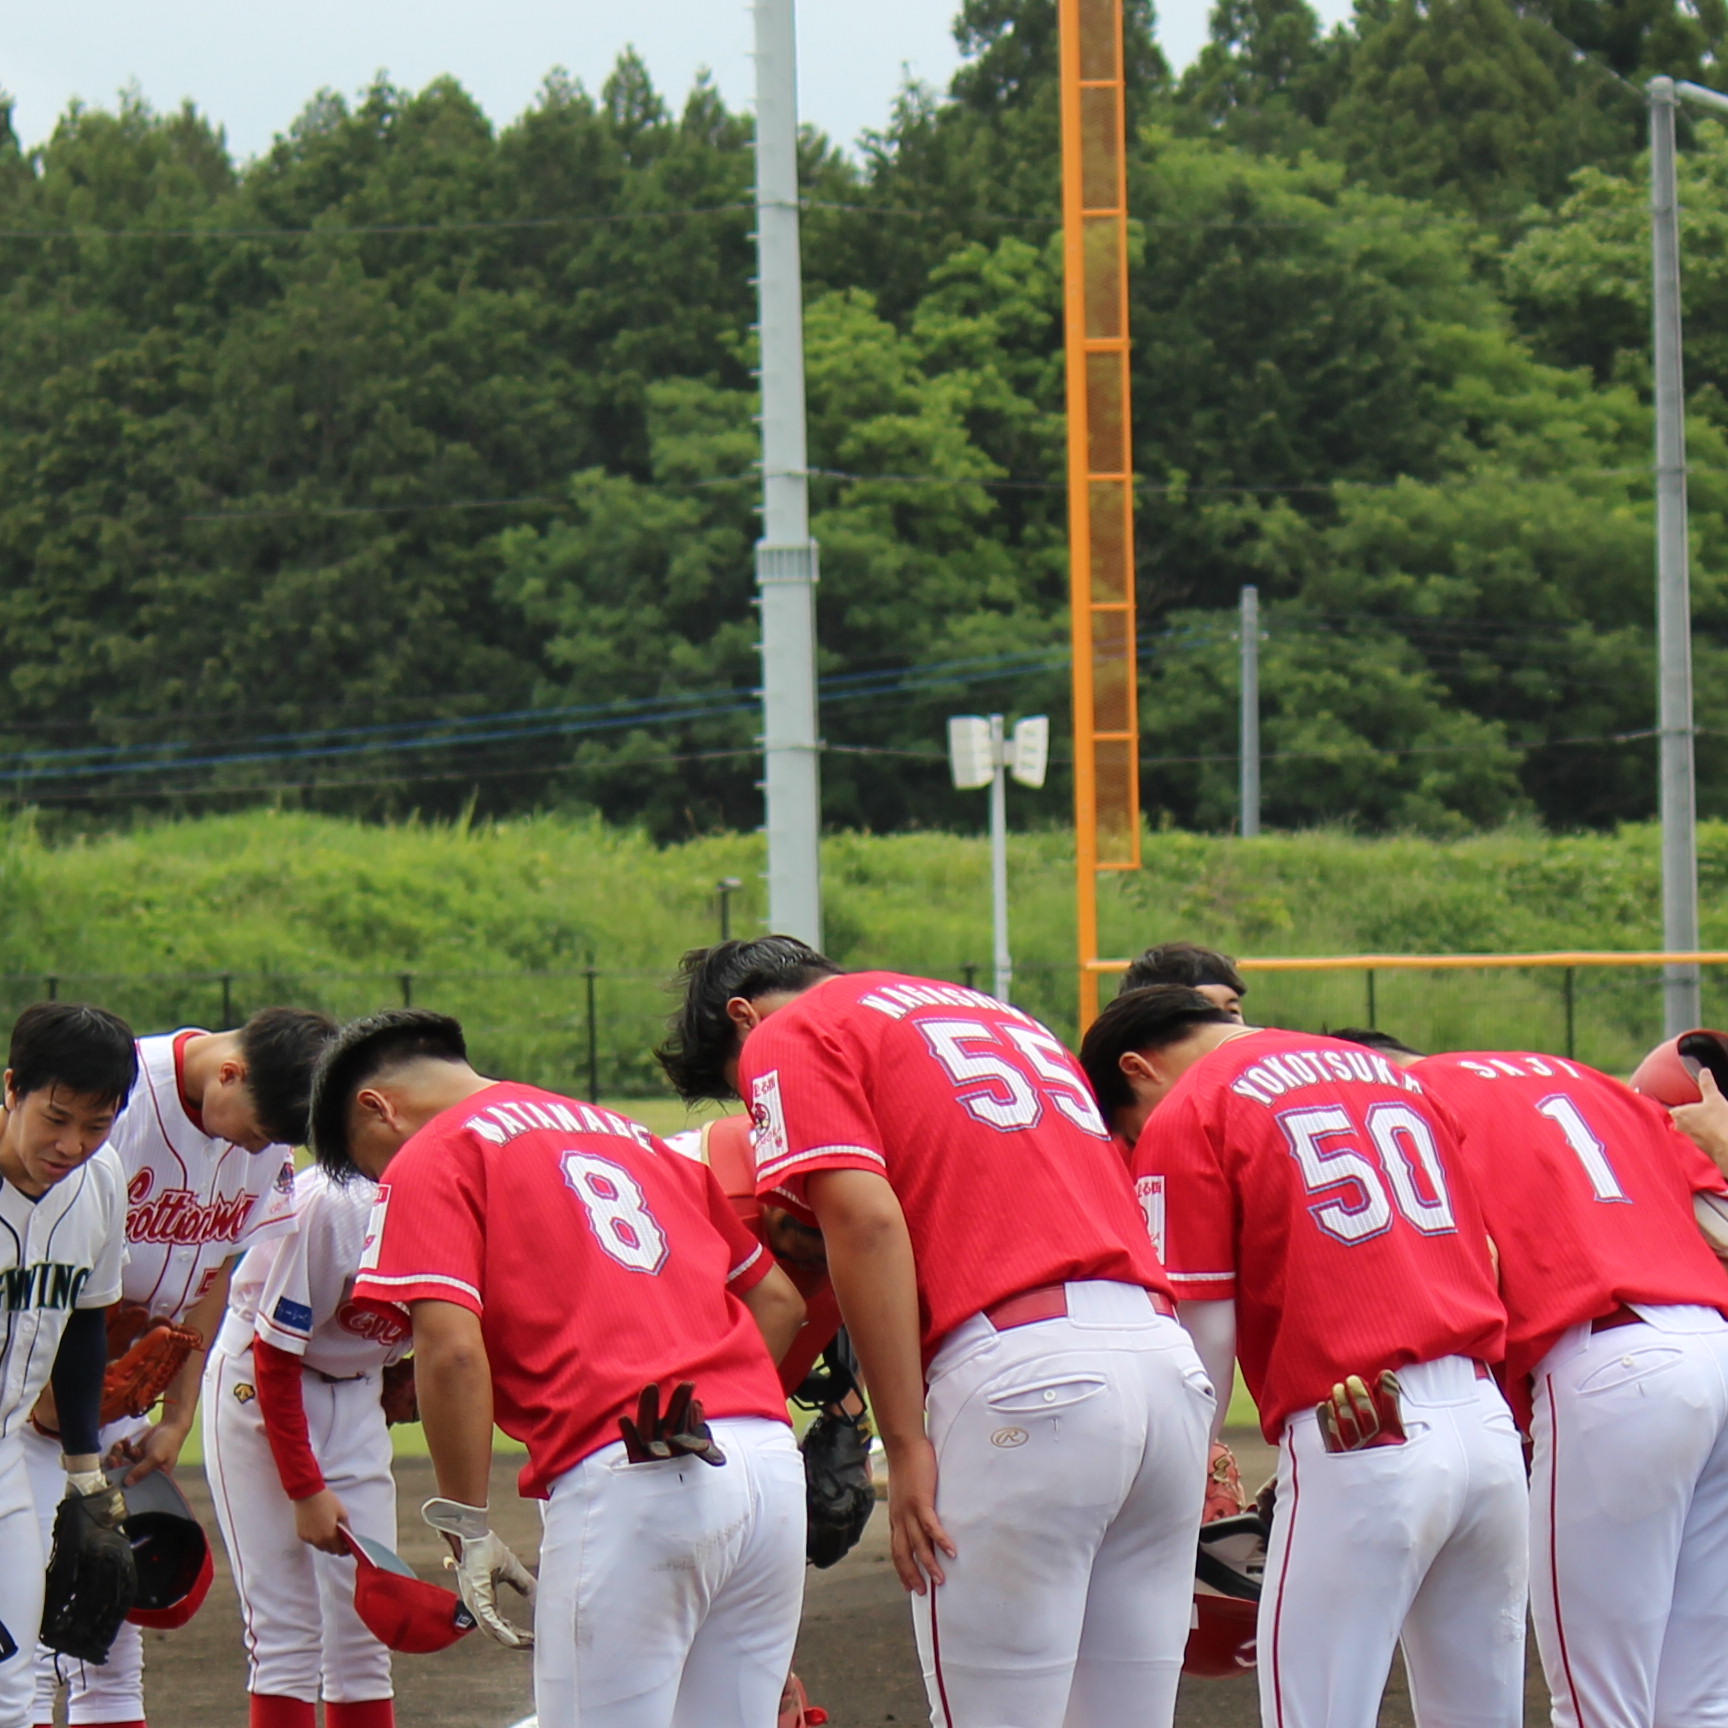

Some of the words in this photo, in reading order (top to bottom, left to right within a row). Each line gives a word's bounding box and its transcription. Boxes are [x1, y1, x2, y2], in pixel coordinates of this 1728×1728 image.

[912, 1016, 1113, 1142] 55
[1230, 1050, 1424, 1108] YOKOTSUKA
[1458, 1057, 1581, 1079] SAJI
[462, 1101, 657, 1155] WATANABE
[1274, 1101, 1459, 1247] 50
[1533, 1093, 1634, 1205] 1
[559, 1150, 670, 1276] 8
